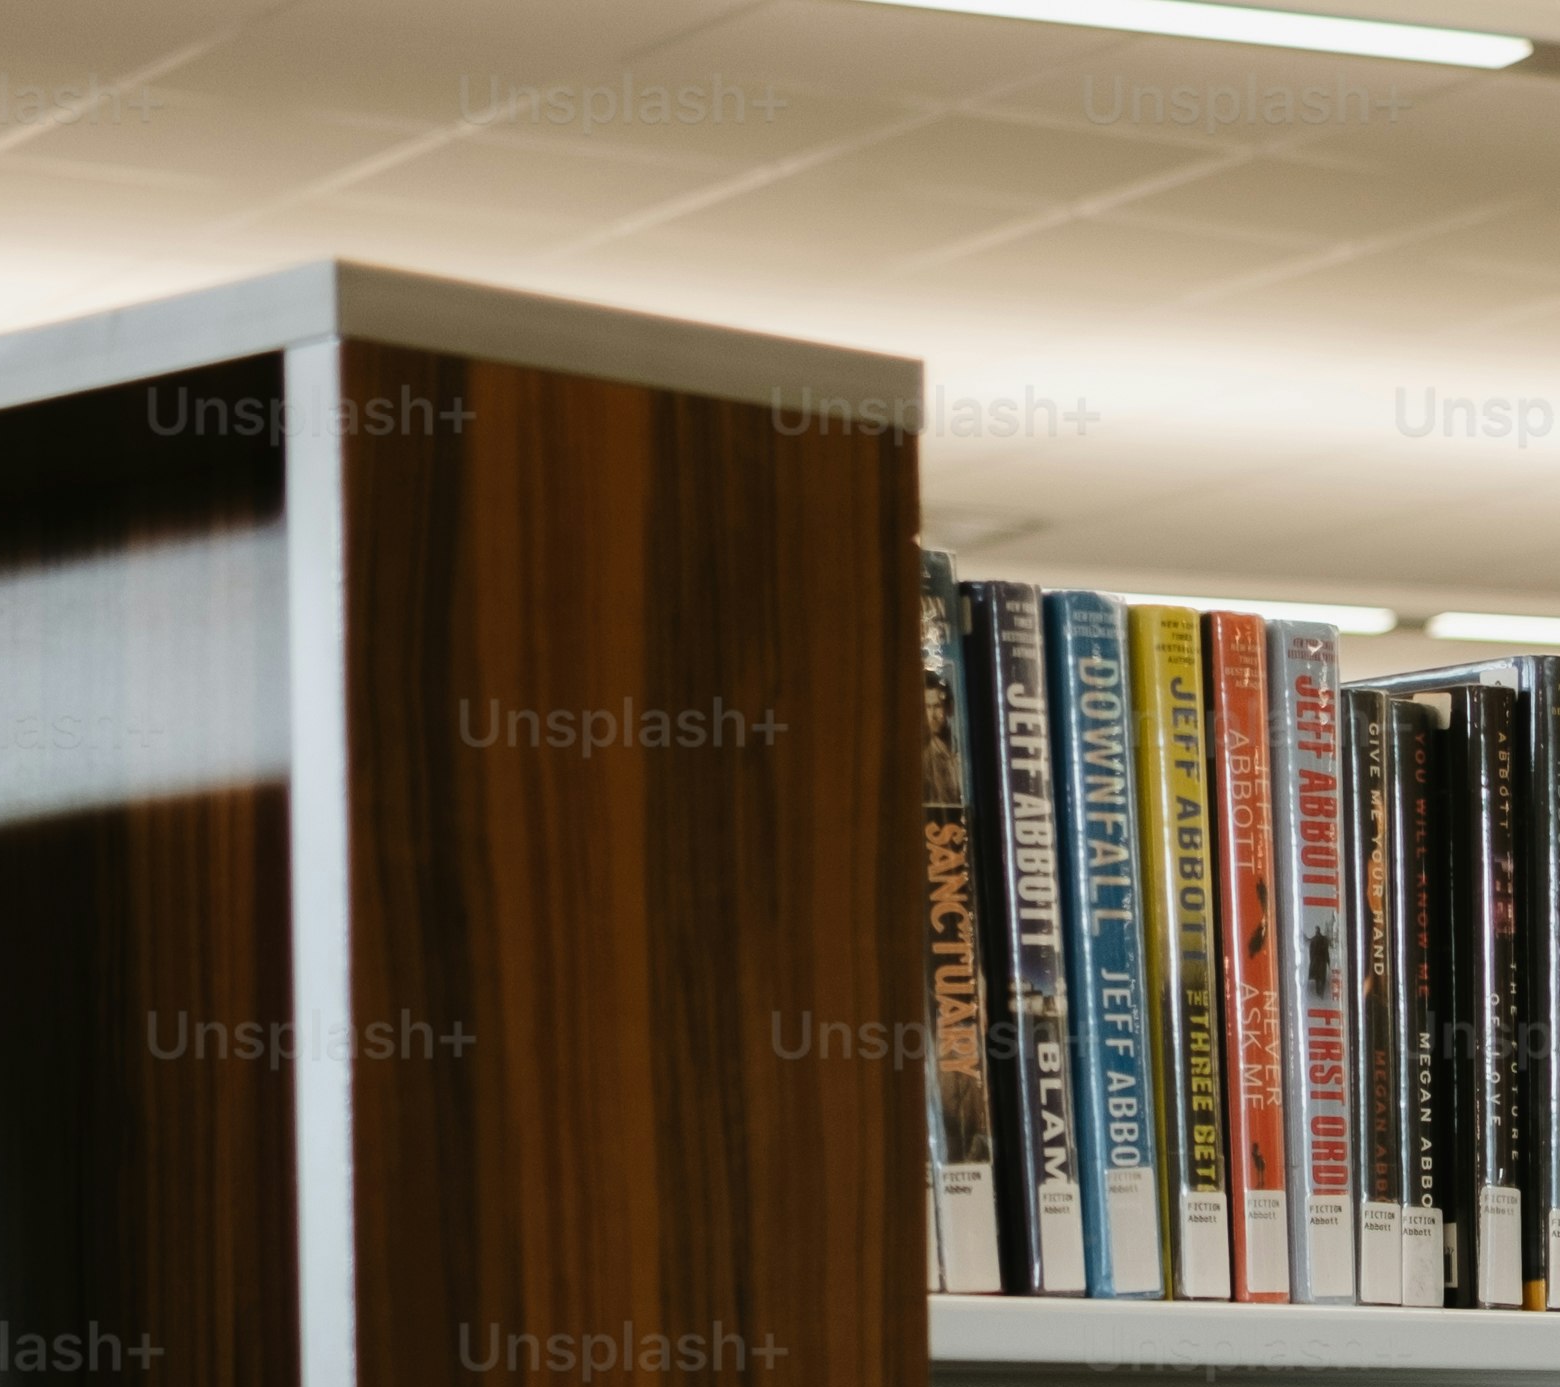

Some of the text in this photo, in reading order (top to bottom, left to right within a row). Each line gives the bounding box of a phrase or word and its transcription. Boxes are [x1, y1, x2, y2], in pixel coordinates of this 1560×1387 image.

[1170, 677, 1199, 781] JEFF
[1294, 675, 1337, 760] JEFF
[1006, 684, 1058, 953] JEFF ABBOTT
[1076, 658, 1130, 937] DOWNFALL
[1297, 768, 1341, 913] ABBOTT
[1368, 723, 1385, 977] GIVE ME YOUR HAND
[925, 819, 981, 1080] SANCTUARY
[1175, 797, 1206, 962] ABBOTT
[1101, 969, 1134, 1059] JEFF
[1188, 1202, 1221, 1212] FICTION
[1188, 1214, 1217, 1224] Abbott
